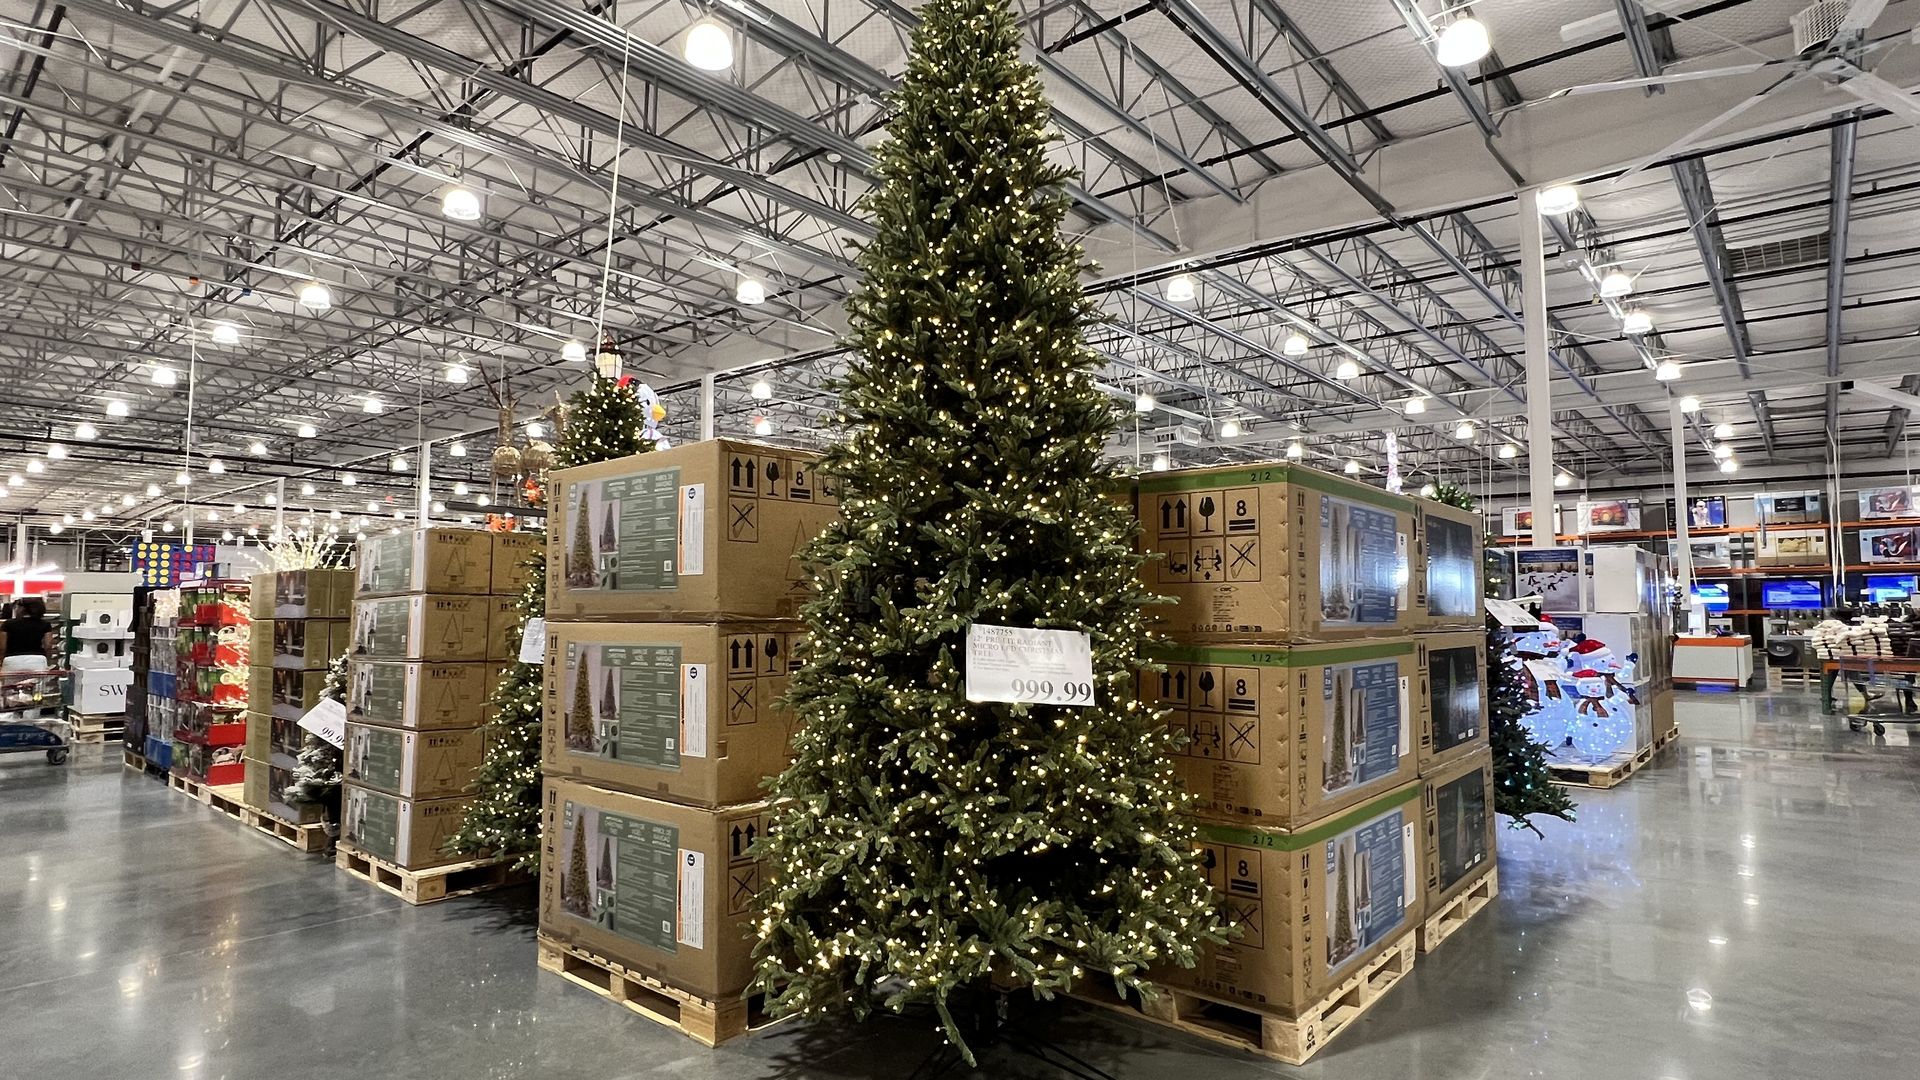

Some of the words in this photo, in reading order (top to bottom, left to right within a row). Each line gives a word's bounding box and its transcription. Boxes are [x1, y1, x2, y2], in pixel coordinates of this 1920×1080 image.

[796, 471, 804, 486] 8
[1236, 499, 1247, 517] 8
[972, 642, 999, 651] MICRO
[1017, 638, 1052, 647] RADIANT
[973, 649, 992, 657] TREE
[1011, 678, 1092, 702] 999.99
[1236, 678, 1247, 696] 8
[320, 727, 345, 747] 99.9
[1238, 860, 1248, 877] 8
